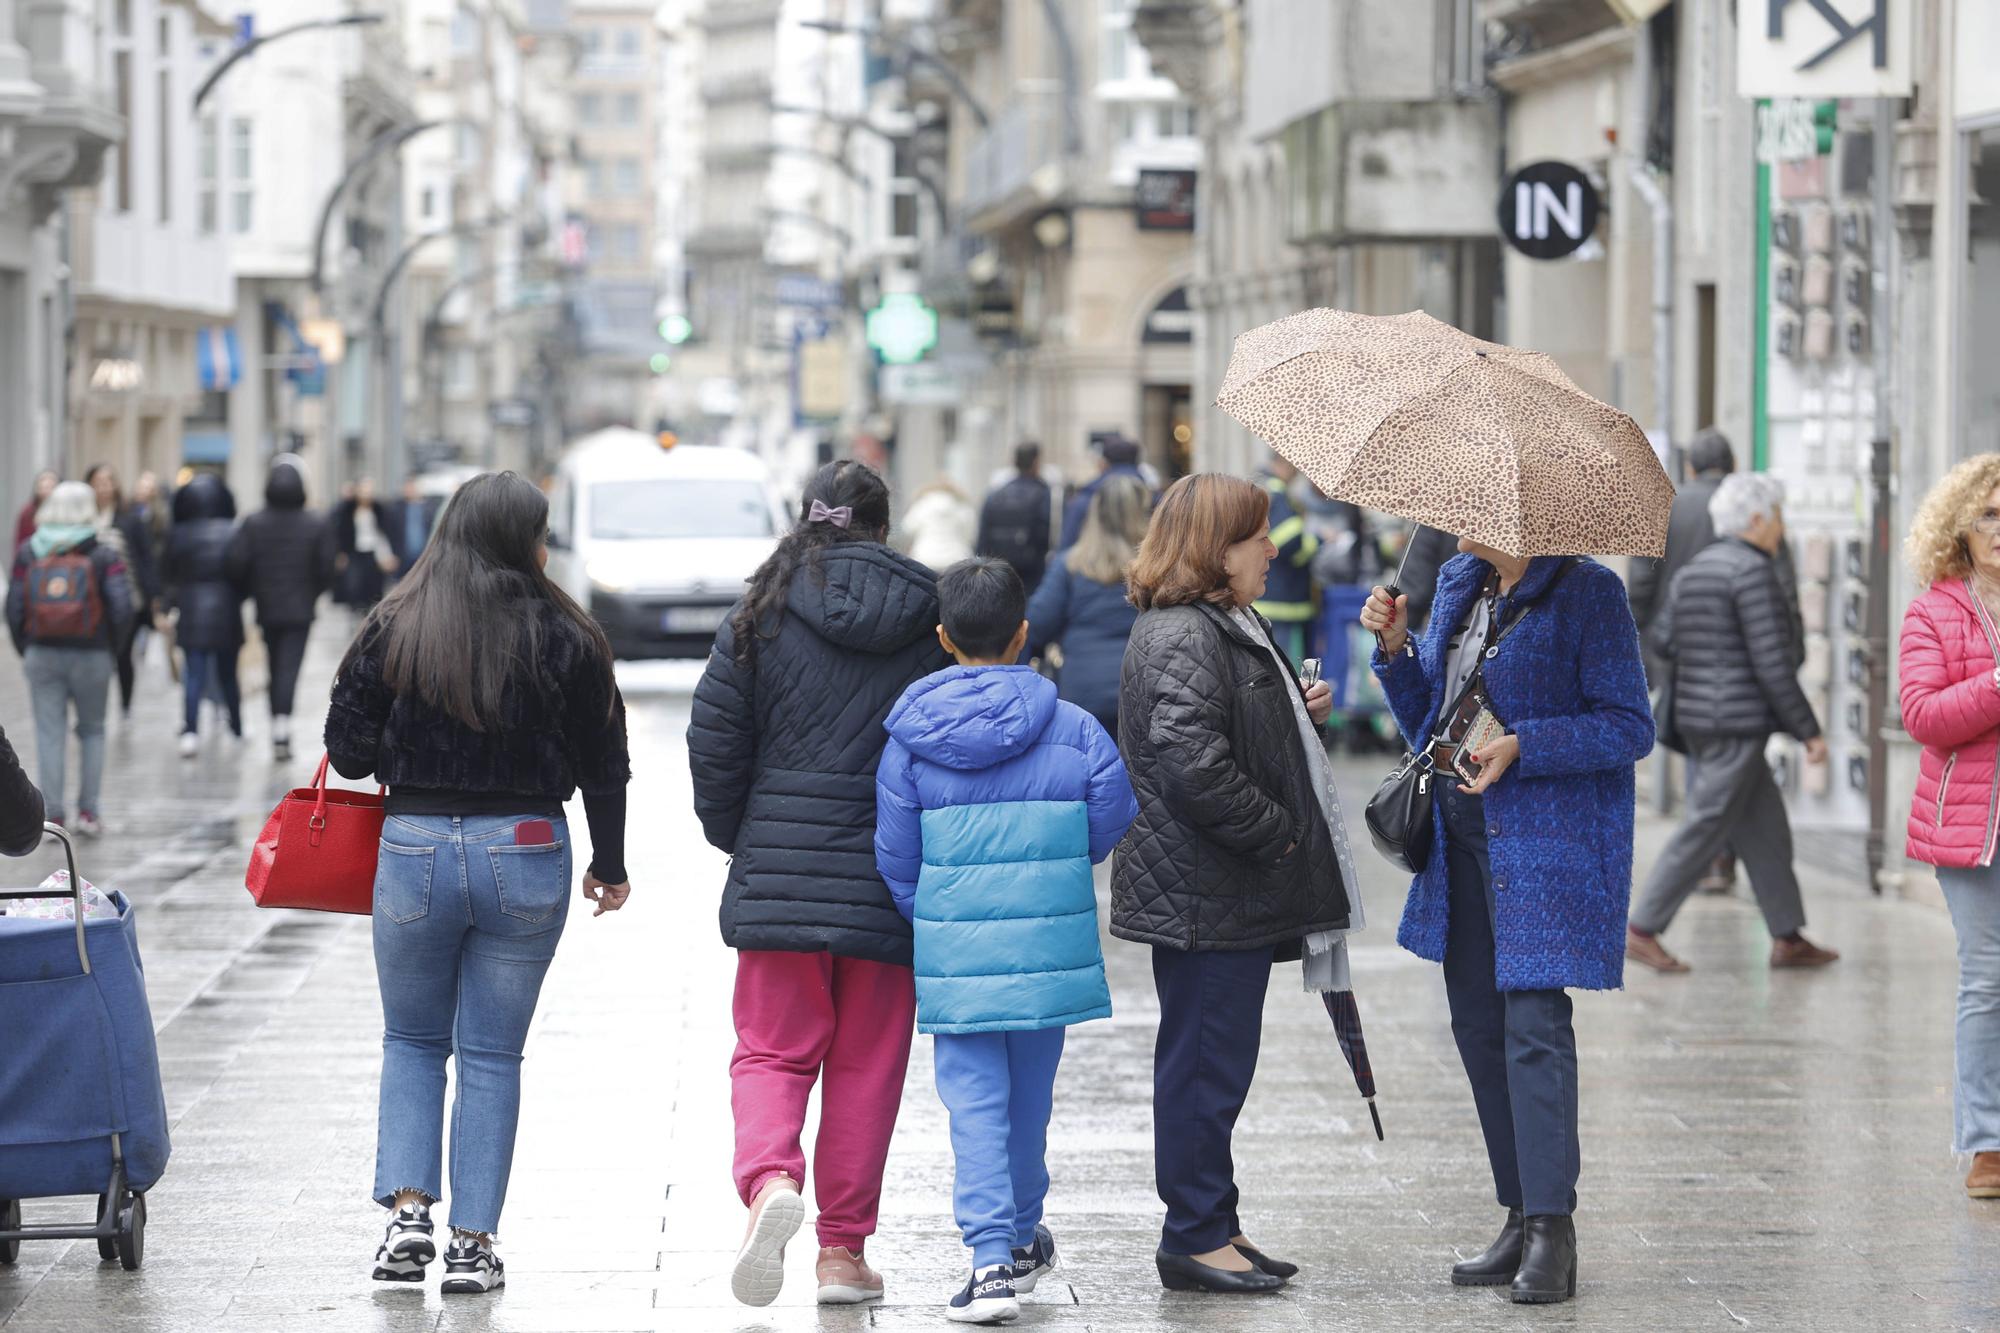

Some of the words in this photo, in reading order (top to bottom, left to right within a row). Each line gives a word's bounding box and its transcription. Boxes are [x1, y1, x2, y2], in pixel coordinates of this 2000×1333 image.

[1515, 181, 1582, 240] IN
[1014, 1259, 1036, 1270] HERS
[973, 1279, 1015, 1298] SKECHE
